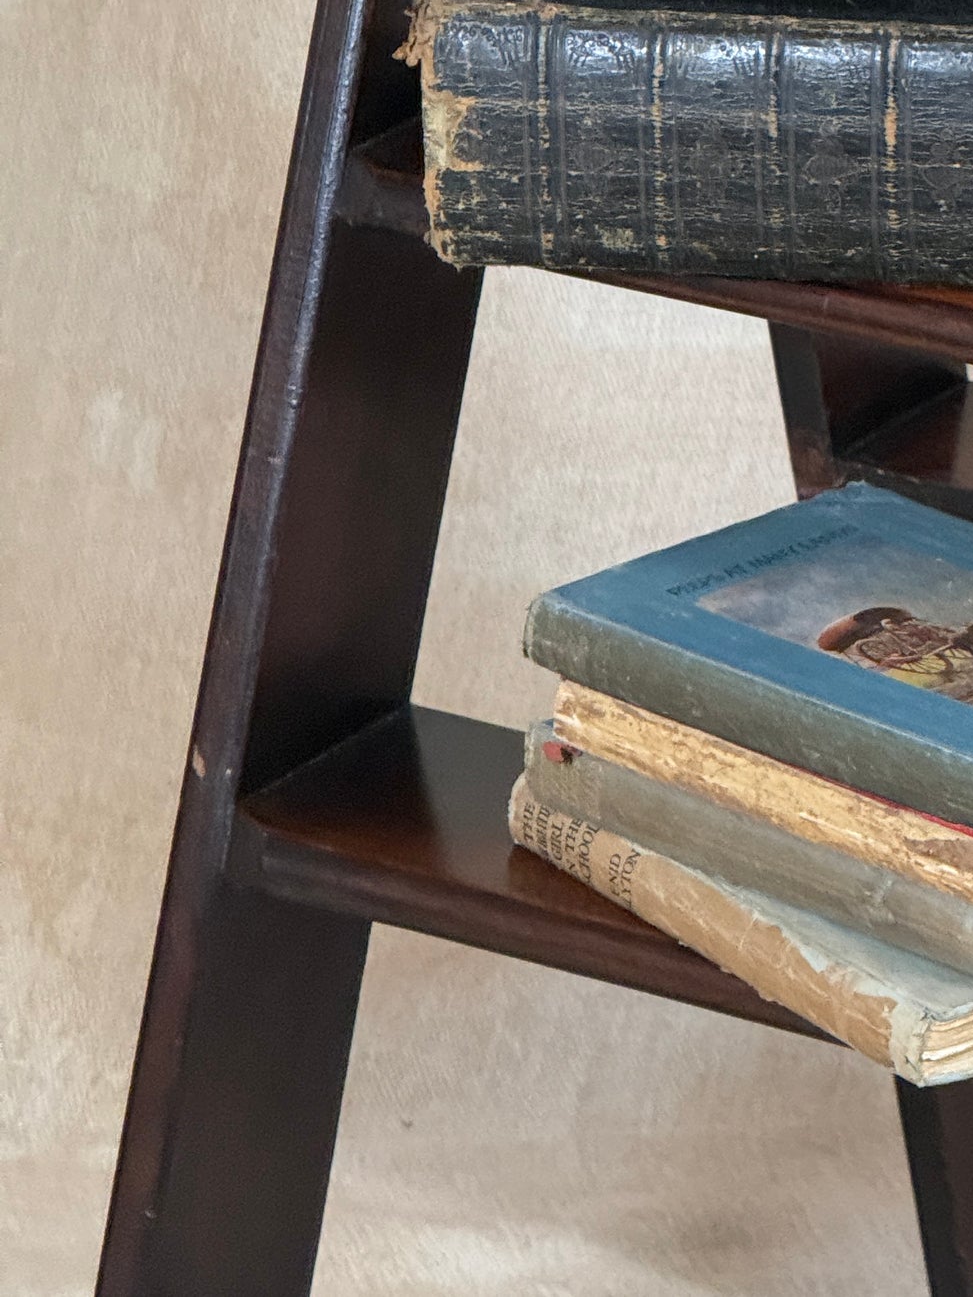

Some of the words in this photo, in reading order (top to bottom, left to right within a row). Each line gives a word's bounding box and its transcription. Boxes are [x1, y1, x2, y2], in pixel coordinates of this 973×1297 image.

[522, 802, 536, 844] THE
[550, 820, 566, 862] GIRL
[564, 817, 585, 854] THE
[609, 852, 623, 898] ENID
